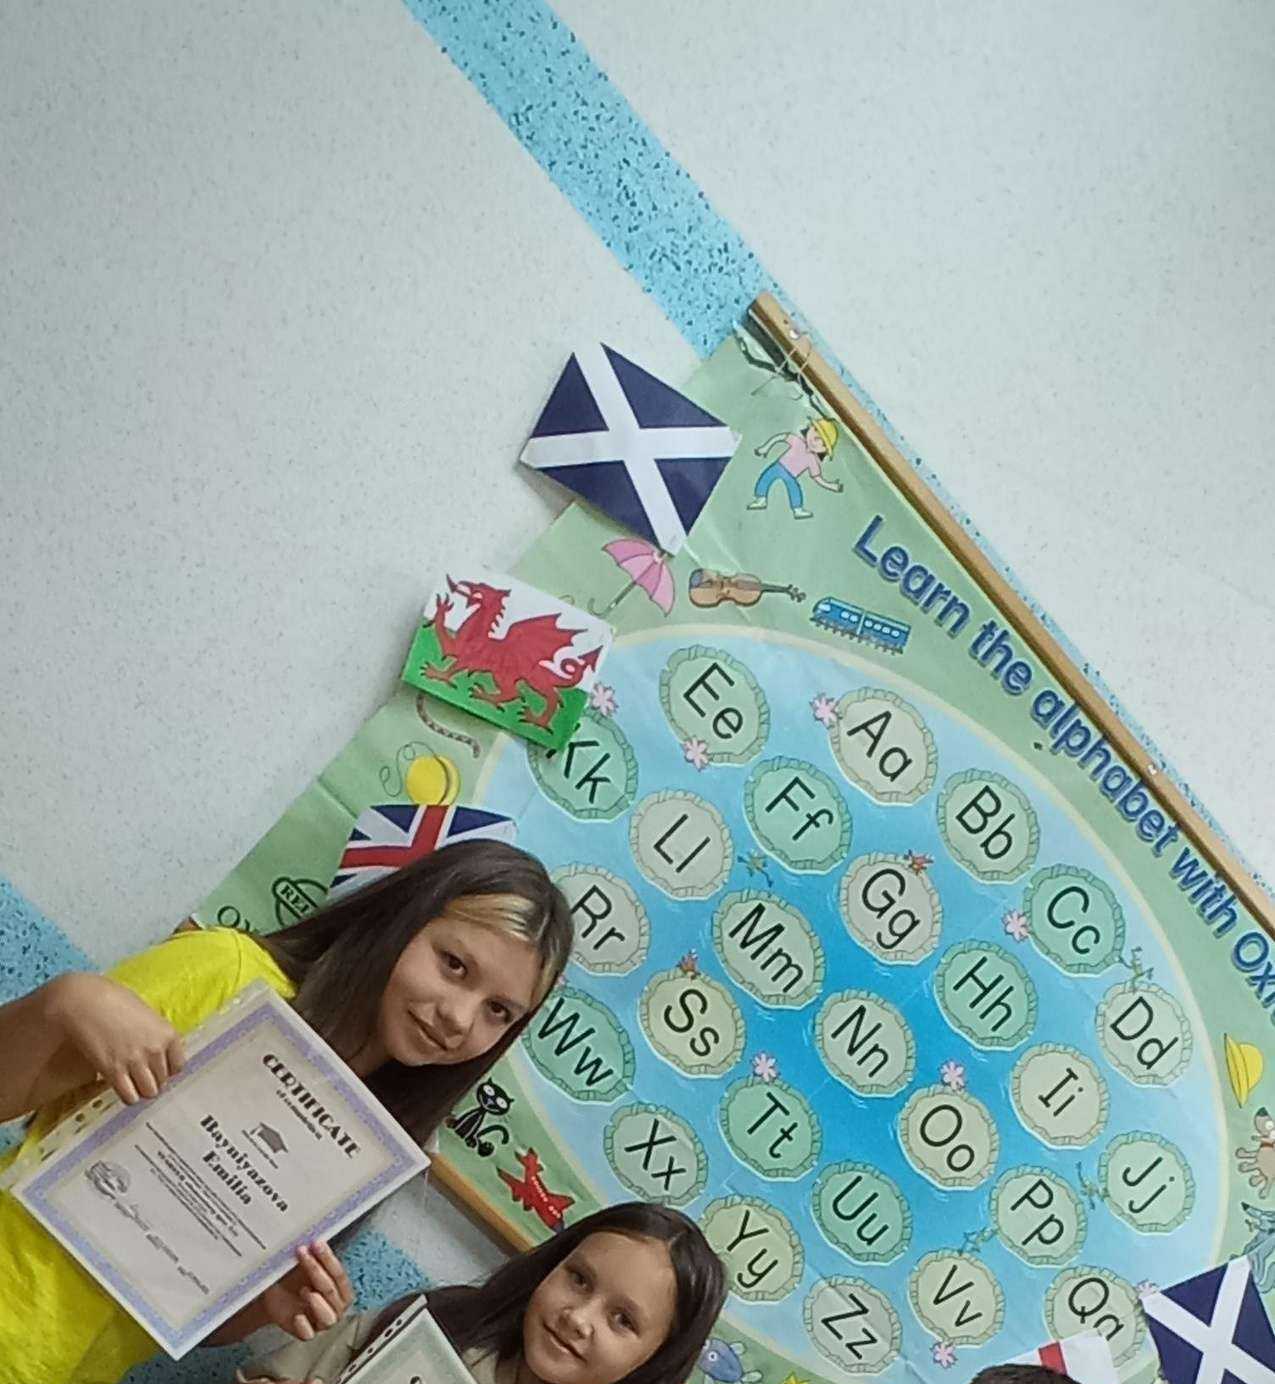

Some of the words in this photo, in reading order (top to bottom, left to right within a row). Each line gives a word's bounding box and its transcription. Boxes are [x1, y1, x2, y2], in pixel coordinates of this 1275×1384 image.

[683, 662, 743, 739] Ee
[765, 776, 834, 841] Ff
[861, 868, 920, 950] Gg
[953, 956, 1014, 1032] Hh
[1038, 1068, 1083, 1117] Ii
[1122, 1157, 1166, 1214] Jj
[847, 711, 912, 782] Aa
[955, 785, 1015, 860] Bb
[1047, 886, 1100, 955] Cc
[1110, 996, 1178, 1070] Dd
[853, 514, 971, 640] Learn
[968, 617, 1034, 696] the
[1032, 686, 1180, 856] alphabet
[1168, 846, 1238, 940] with
[1231, 930, 1275, 1010] Ox
[200, 1115, 289, 1212] Bayniyazova
[202, 1150, 252, 1205] Emilia
[262, 1053, 360, 1158] CERTIFICATE
[537, 997, 614, 1087] Ww
[624, 1118, 686, 1191] Xx
[726, 1210, 778, 1289] Yy
[821, 1293, 878, 1360] Zz
[569, 884, 626, 952] Rr
[663, 989, 720, 1057] Ss
[747, 1091, 798, 1159] Tt
[832, 1175, 889, 1246] Uu
[933, 1264, 982, 1327] Vv
[728, 902, 803, 993] Mm
[831, 1004, 889, 1078] Nn
[920, 1104, 975, 1172] Oo
[1010, 1178, 1064, 1246] Pp
